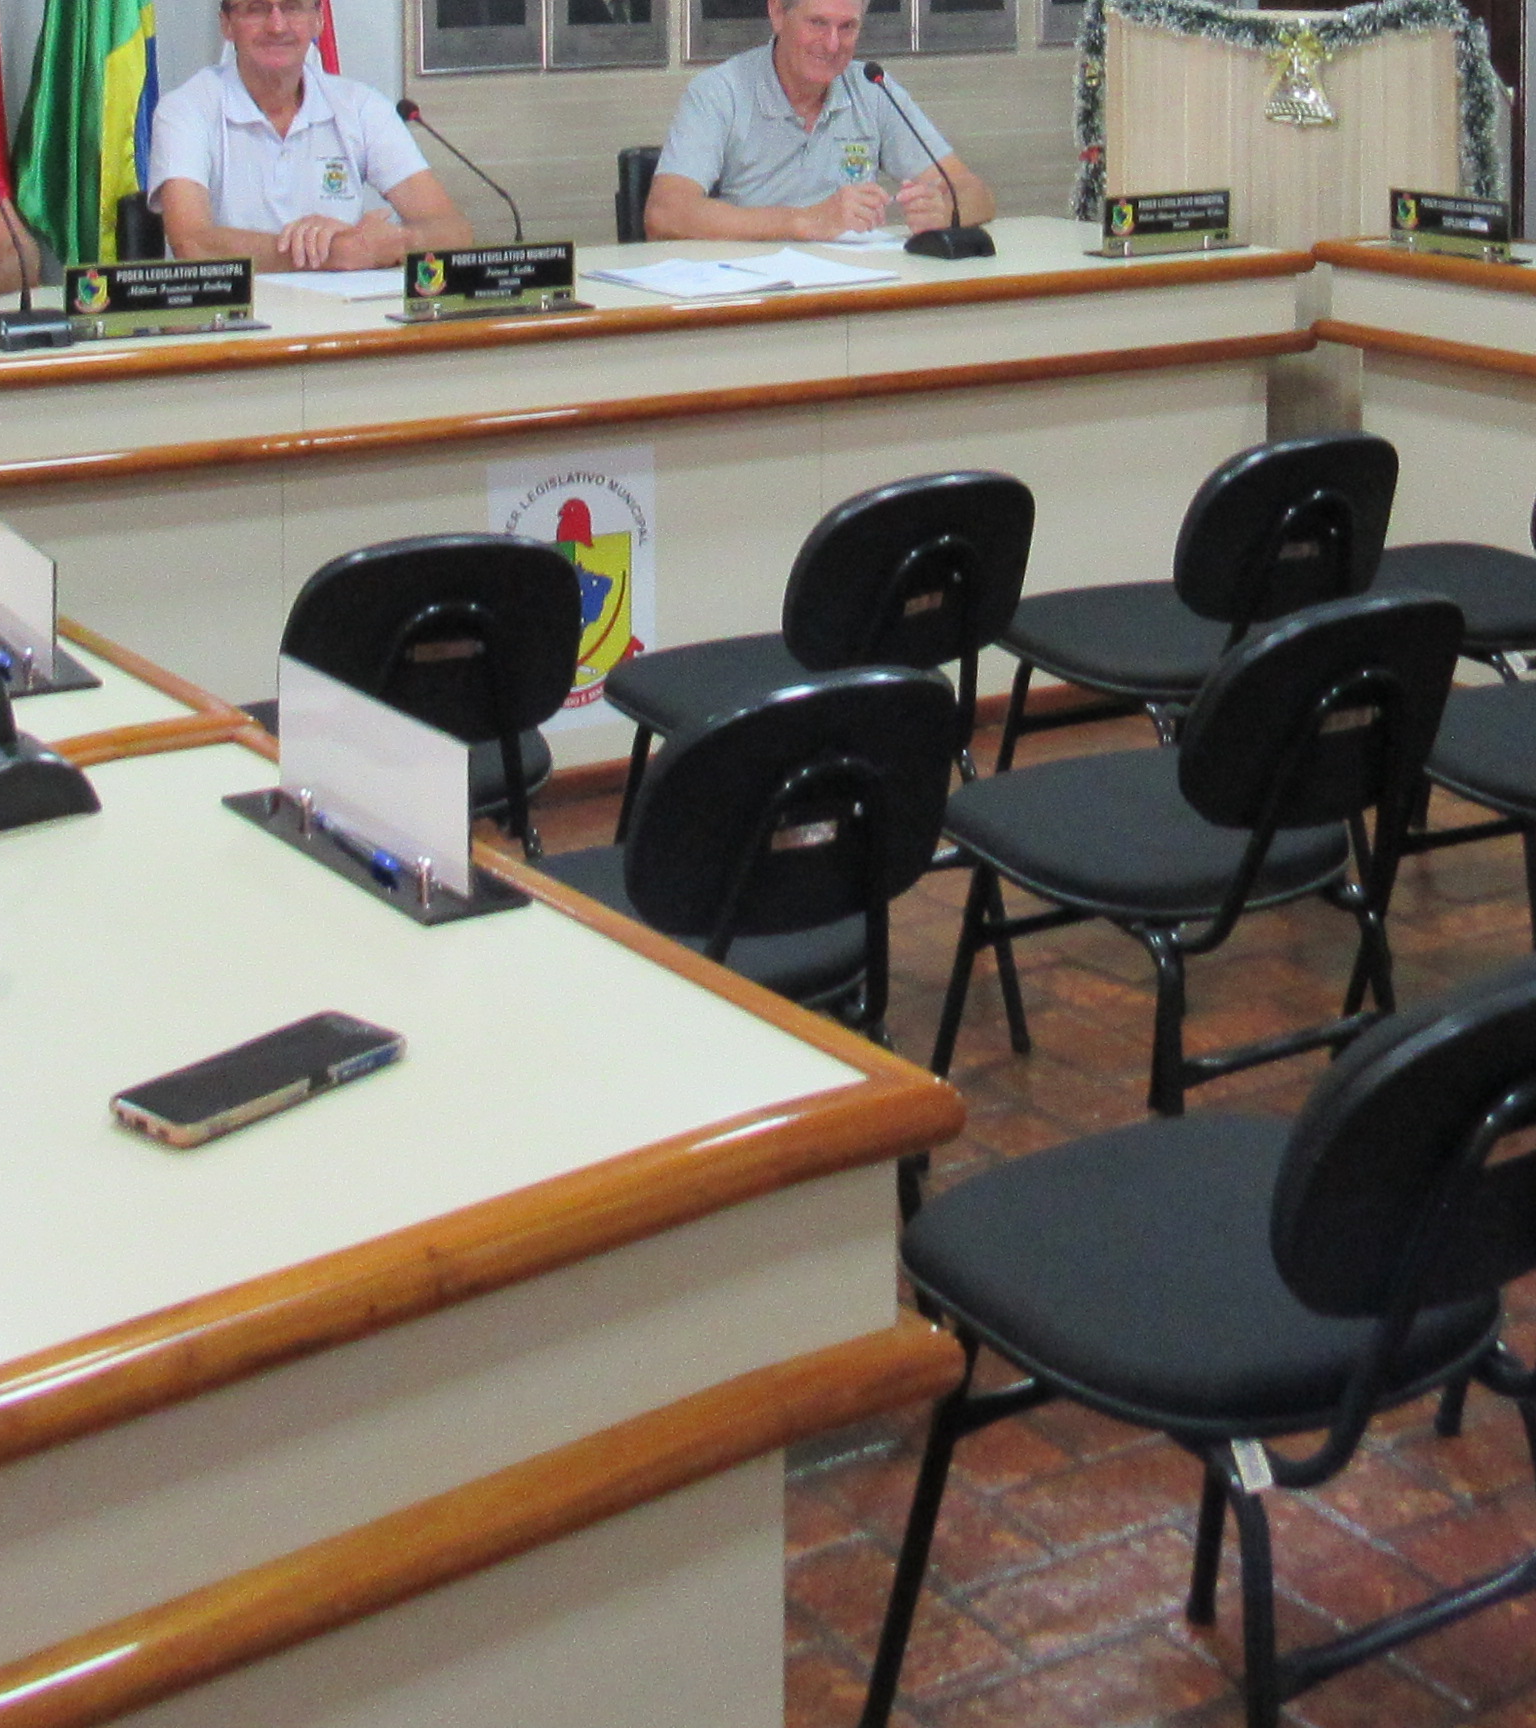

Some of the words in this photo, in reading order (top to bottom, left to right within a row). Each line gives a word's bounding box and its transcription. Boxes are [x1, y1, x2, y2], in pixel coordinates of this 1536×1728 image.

[116, 269, 145, 283] PODER
[145, 265, 198, 281] LEGISLATIVO
[199, 263, 244, 277] MUNICIPAL
[519, 471, 606, 511] LEGISLATIVO
[608, 479, 649, 547] MUNICIPAL
